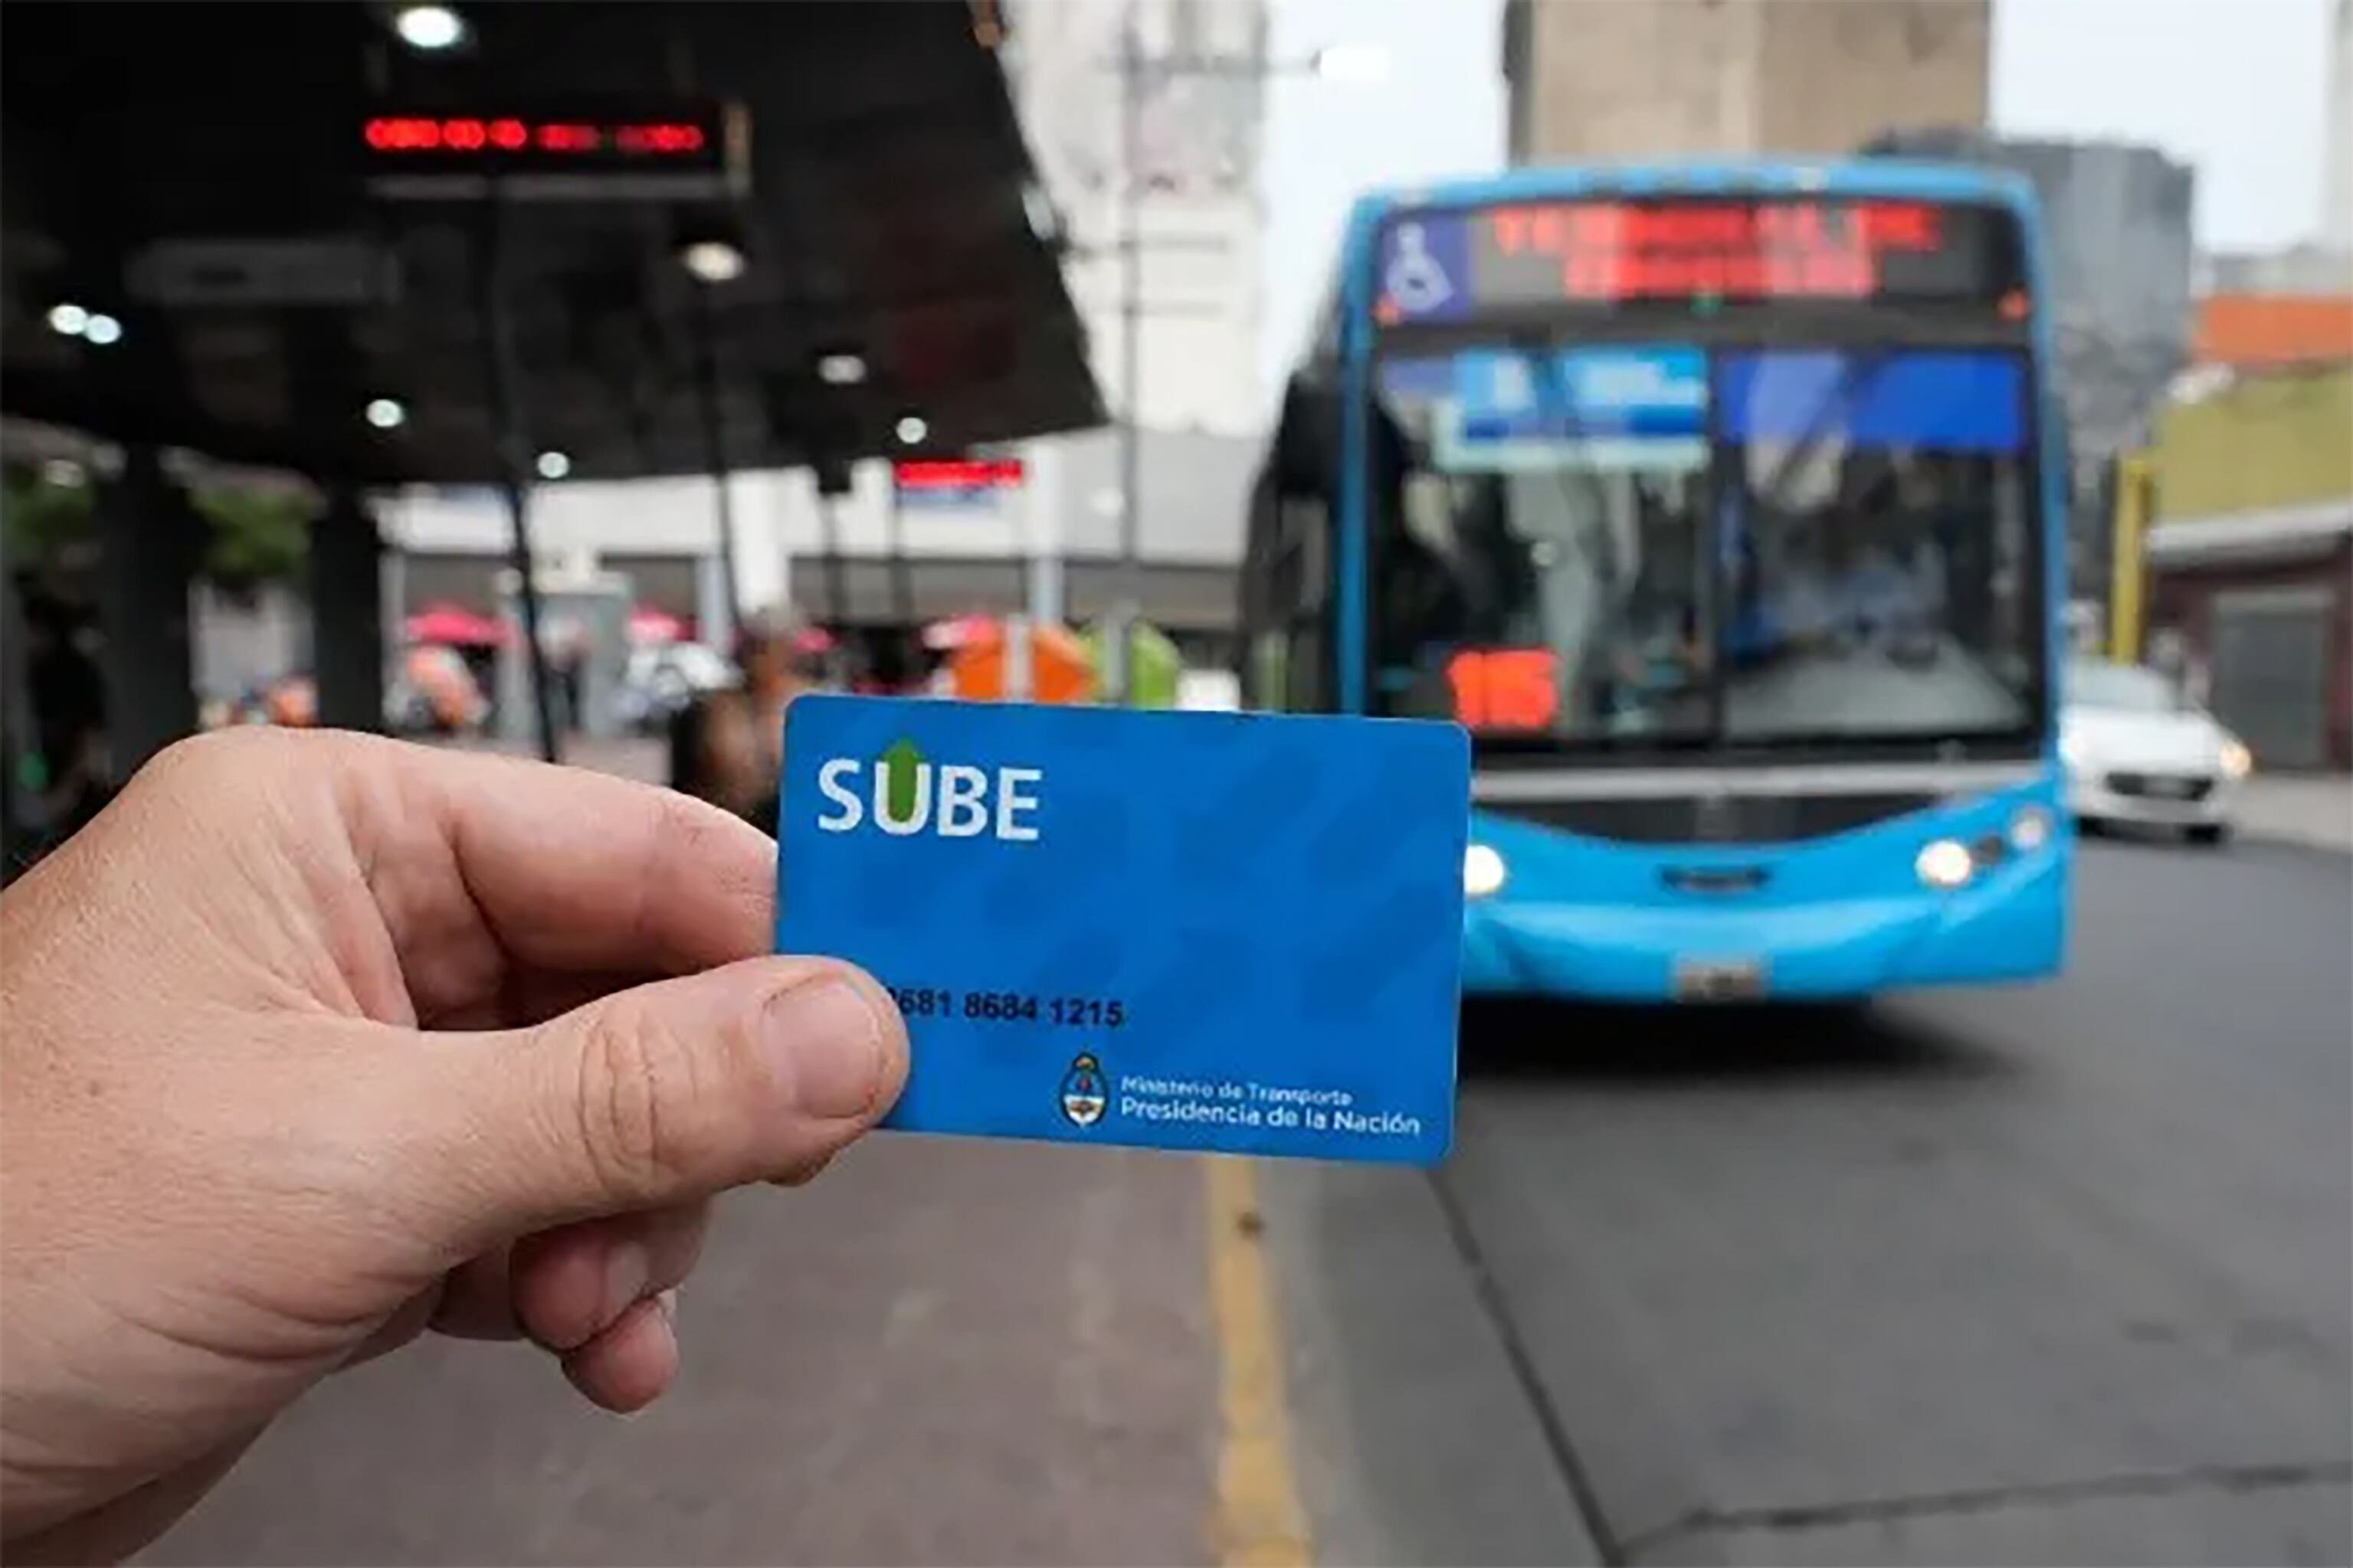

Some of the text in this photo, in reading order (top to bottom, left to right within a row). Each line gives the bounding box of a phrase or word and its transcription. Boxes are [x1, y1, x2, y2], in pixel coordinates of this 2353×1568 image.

[817, 757, 1043, 842] SUBE
[965, 992, 1037, 1022] 8684
[1049, 997, 1123, 1027] 1215
[1121, 1075, 1353, 1107] Ministerio de Transporte
[1121, 1097, 1421, 1137] Presidencia de la Nación
